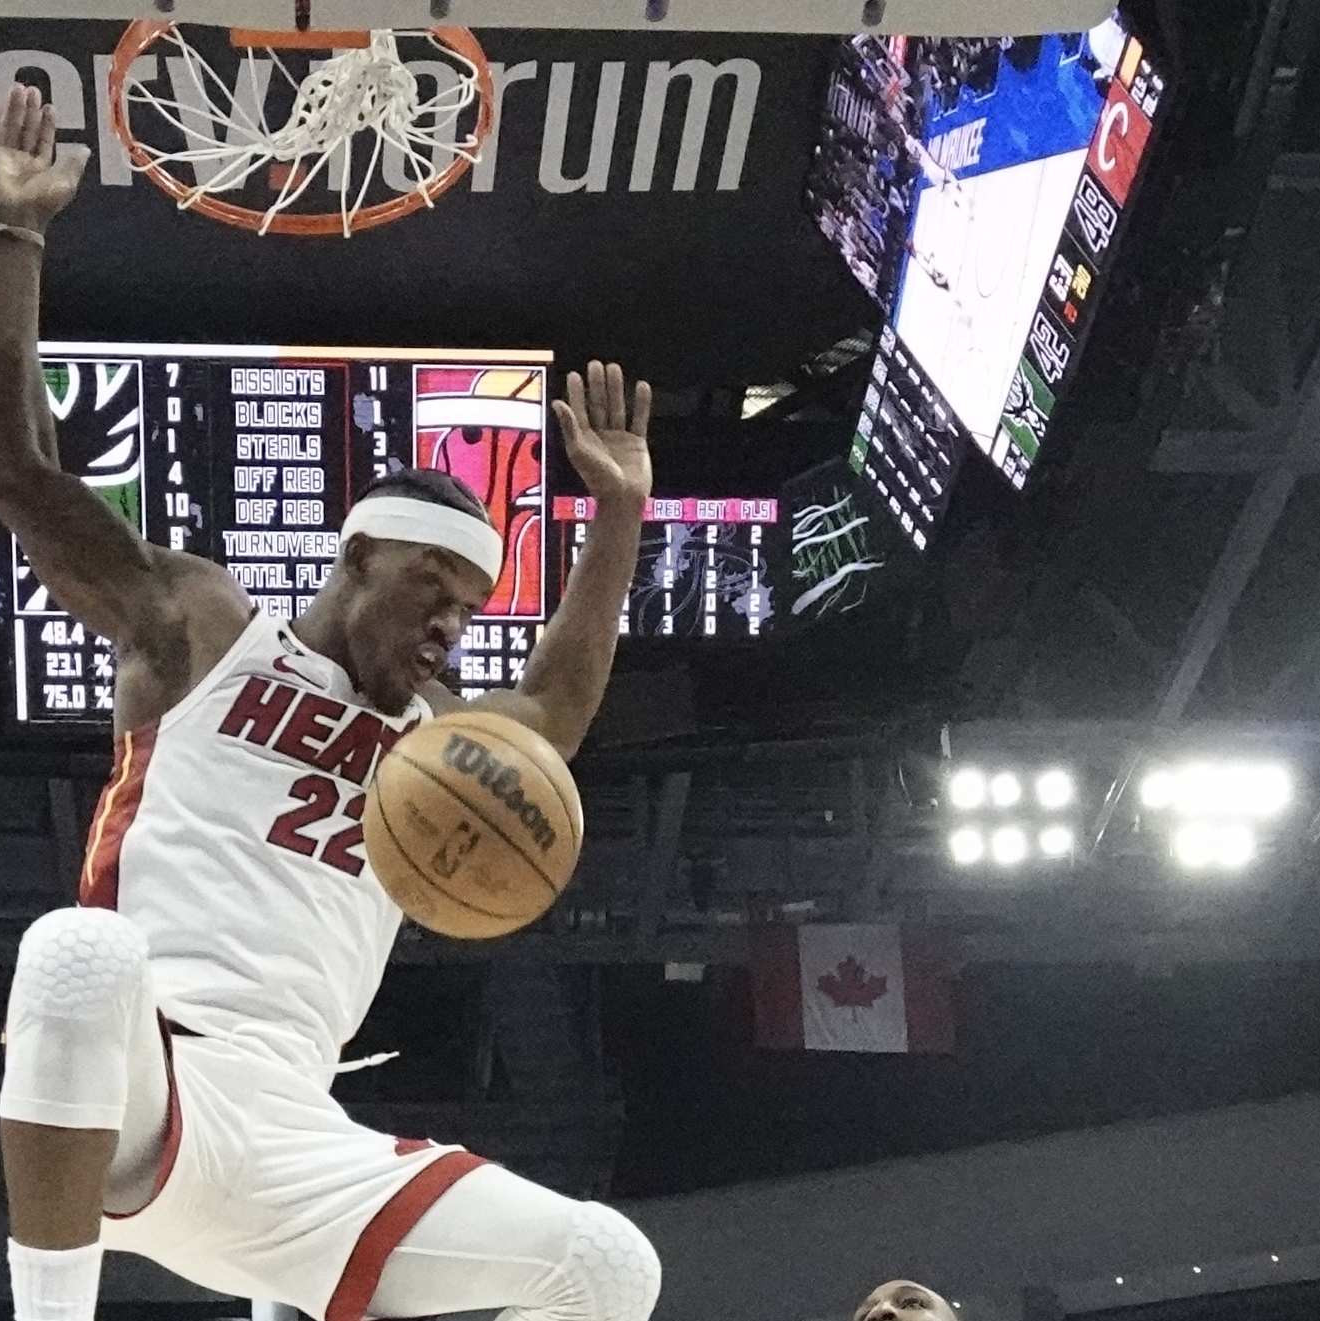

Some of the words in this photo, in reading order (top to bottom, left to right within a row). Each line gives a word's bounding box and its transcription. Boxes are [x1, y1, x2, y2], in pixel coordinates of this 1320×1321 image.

[1074, 175, 1117, 253] 48
[1031, 312, 1070, 383] 42
[166, 363, 179, 387] 7
[231, 368, 325, 395] ASSISTS
[369, 366, 387, 391] 11
[167, 397, 181, 422] 0
[235, 401, 322, 428] BLOCKS
[372, 400, 381, 425] 1
[168, 428, 176, 453] 1
[237, 434, 321, 460] STEALS
[373, 431, 387, 456] 3
[168, 461, 183, 485] 4
[234, 466, 277, 492] OFF
[282, 467, 325, 493] REB
[165, 493, 190, 517] 10
[235, 498, 277, 524] DEF
[282, 499, 325, 525] REB
[653, 499, 683, 519] REB
[697, 500, 726, 520] AST
[740, 500, 770, 520] FLS
[170, 526, 184, 550] 9
[222, 530, 339, 557] TURNOVERS
[227, 563, 292, 589] TOTAL
[41, 620, 85, 645] 48.4
[46, 652, 82, 676] 23.1
[460, 656, 503, 680] 55.6
[43, 684, 85, 709] 75.0
[266, 773, 367, 878] 22
